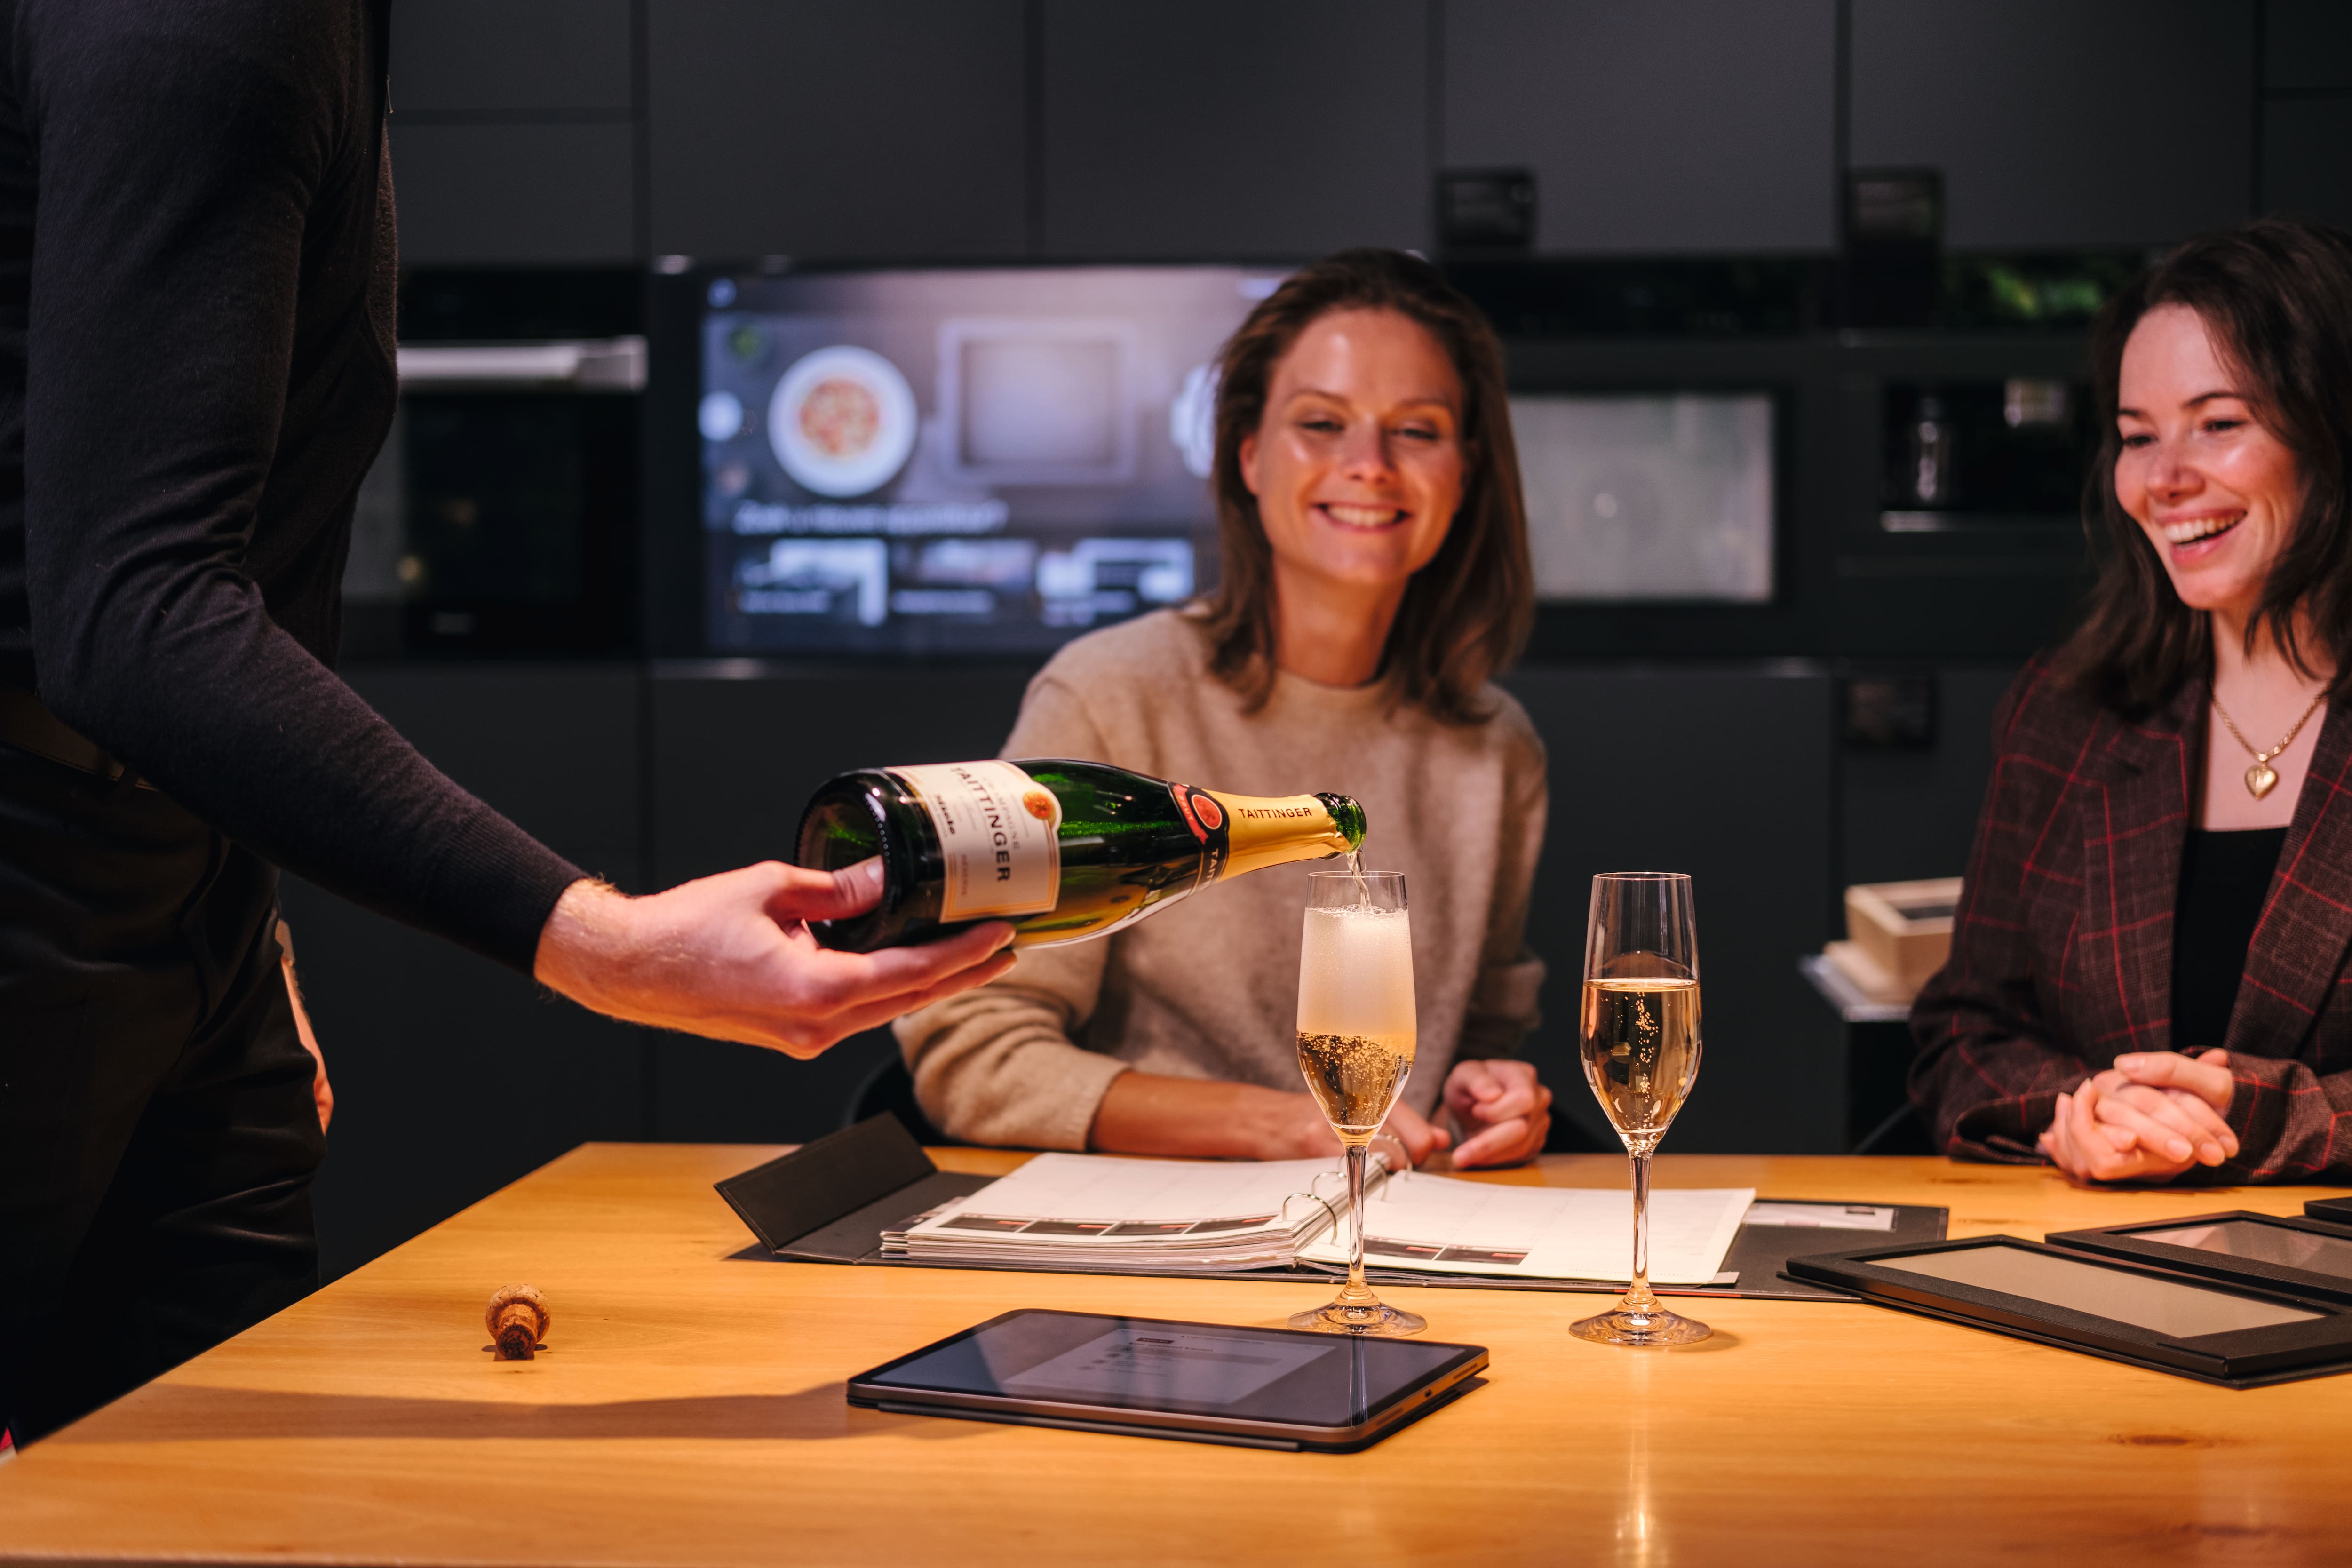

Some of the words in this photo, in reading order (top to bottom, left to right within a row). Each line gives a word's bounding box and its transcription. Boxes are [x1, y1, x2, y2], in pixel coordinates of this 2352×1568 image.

[1179, 796, 1194, 820] BRUT
[1238, 807, 1312, 819] TAITTINGER
[950, 767, 1011, 882] TAITTINGER
